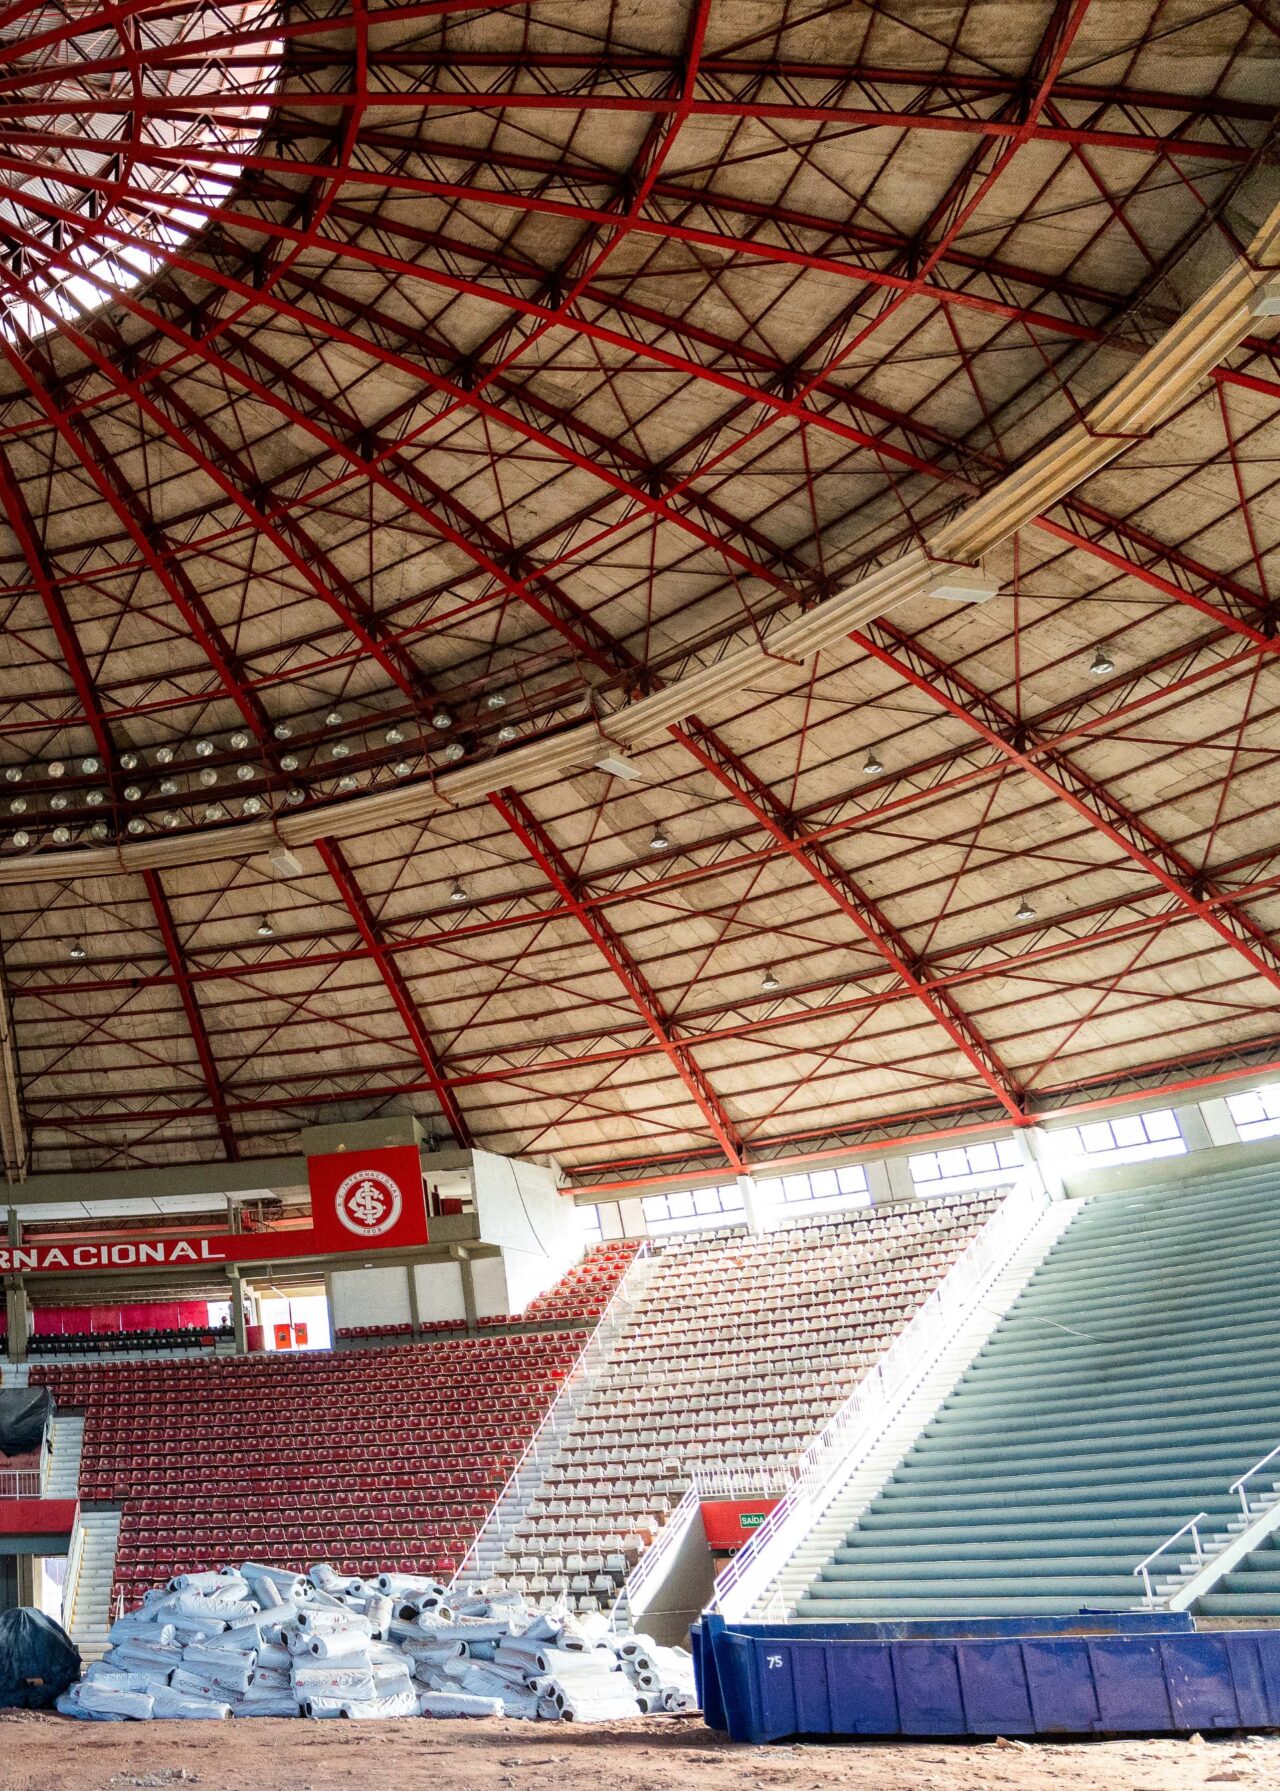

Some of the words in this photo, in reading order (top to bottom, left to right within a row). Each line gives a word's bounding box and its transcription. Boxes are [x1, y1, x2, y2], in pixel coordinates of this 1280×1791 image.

[342, 1172, 399, 1199] INTERNACIONAL
[741, 1515, 764, 1525] SAÍDA
[766, 1655, 783, 1669] 75
